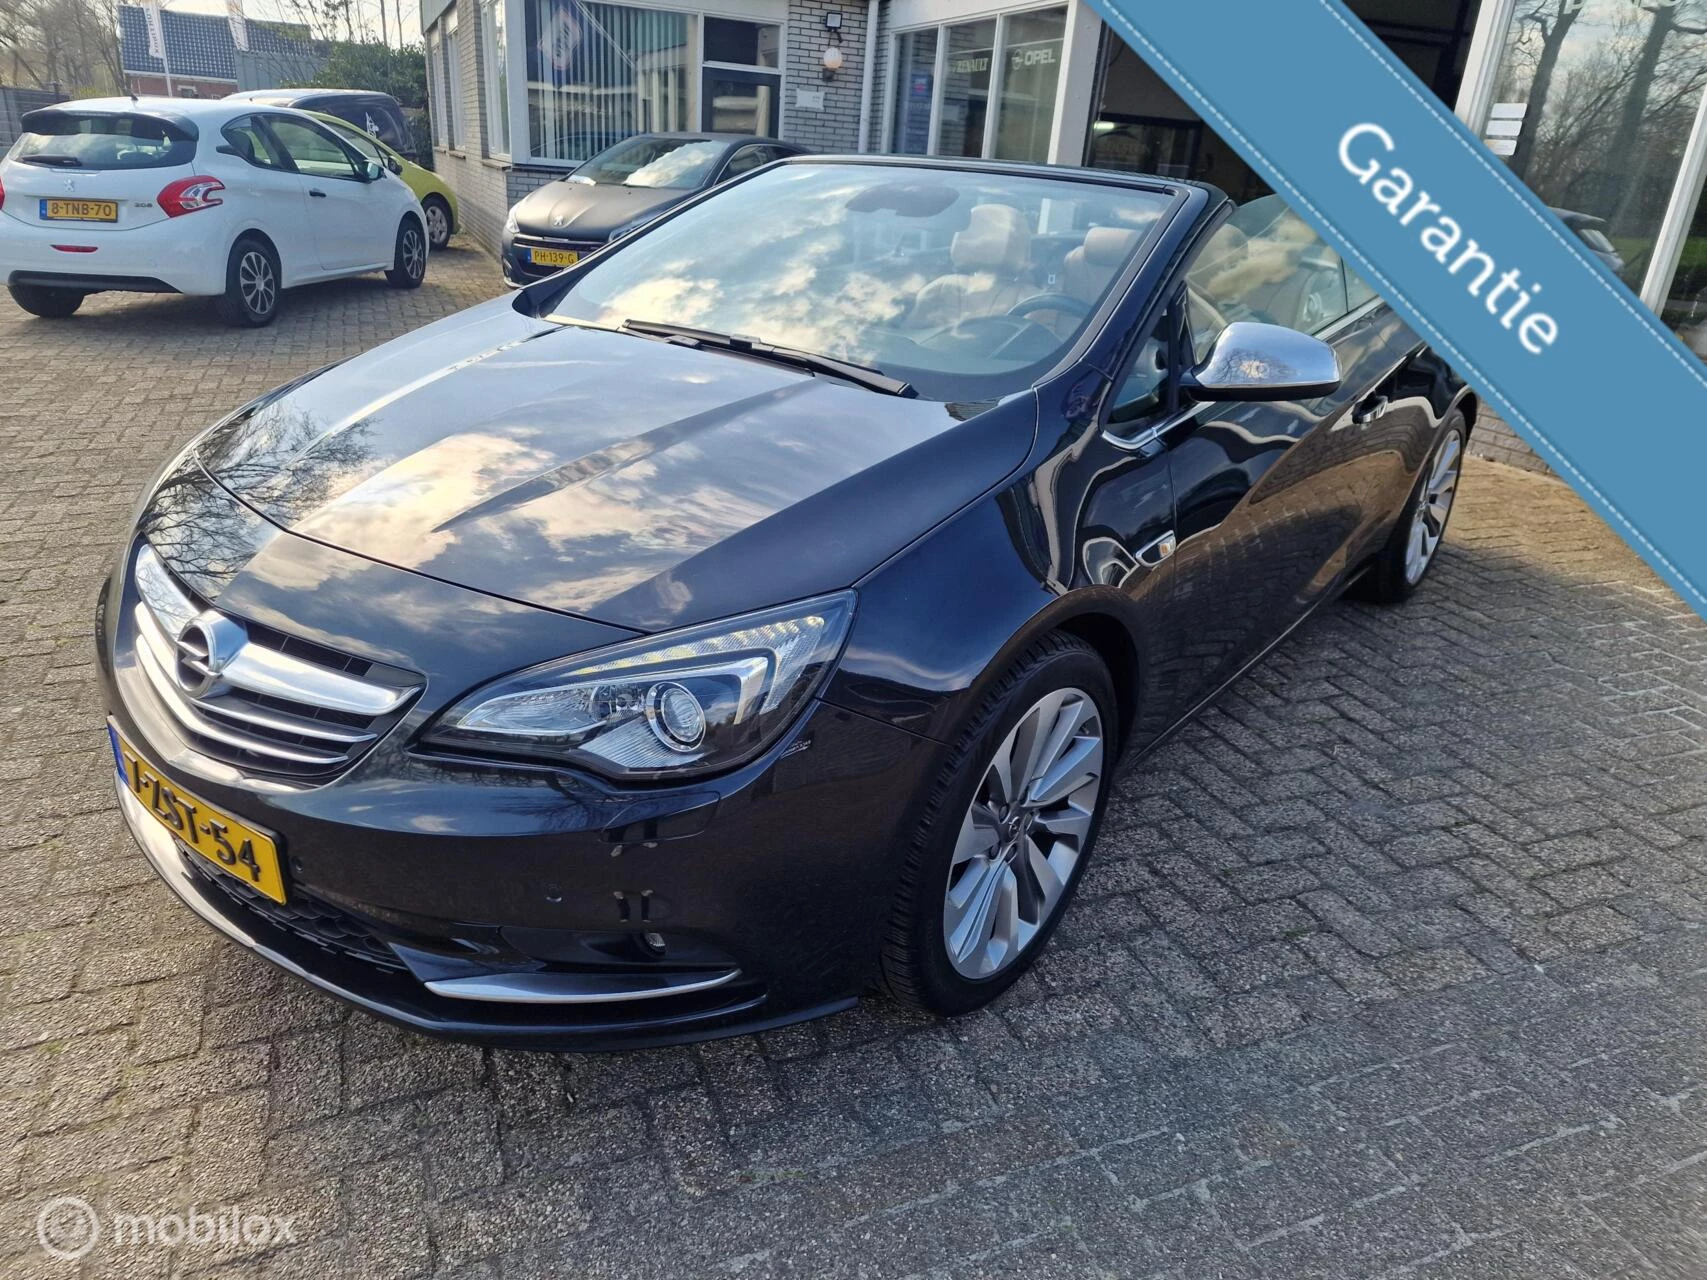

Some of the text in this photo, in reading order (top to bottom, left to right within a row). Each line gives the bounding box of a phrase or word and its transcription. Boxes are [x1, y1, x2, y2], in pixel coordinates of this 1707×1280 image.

[1024, 48, 1056, 66] OPEL
[51, 202, 112, 217] 8-TNB-70
[534, 250, 575, 264] PH-139-G
[124, 750, 261, 883] 1-ZST-54
